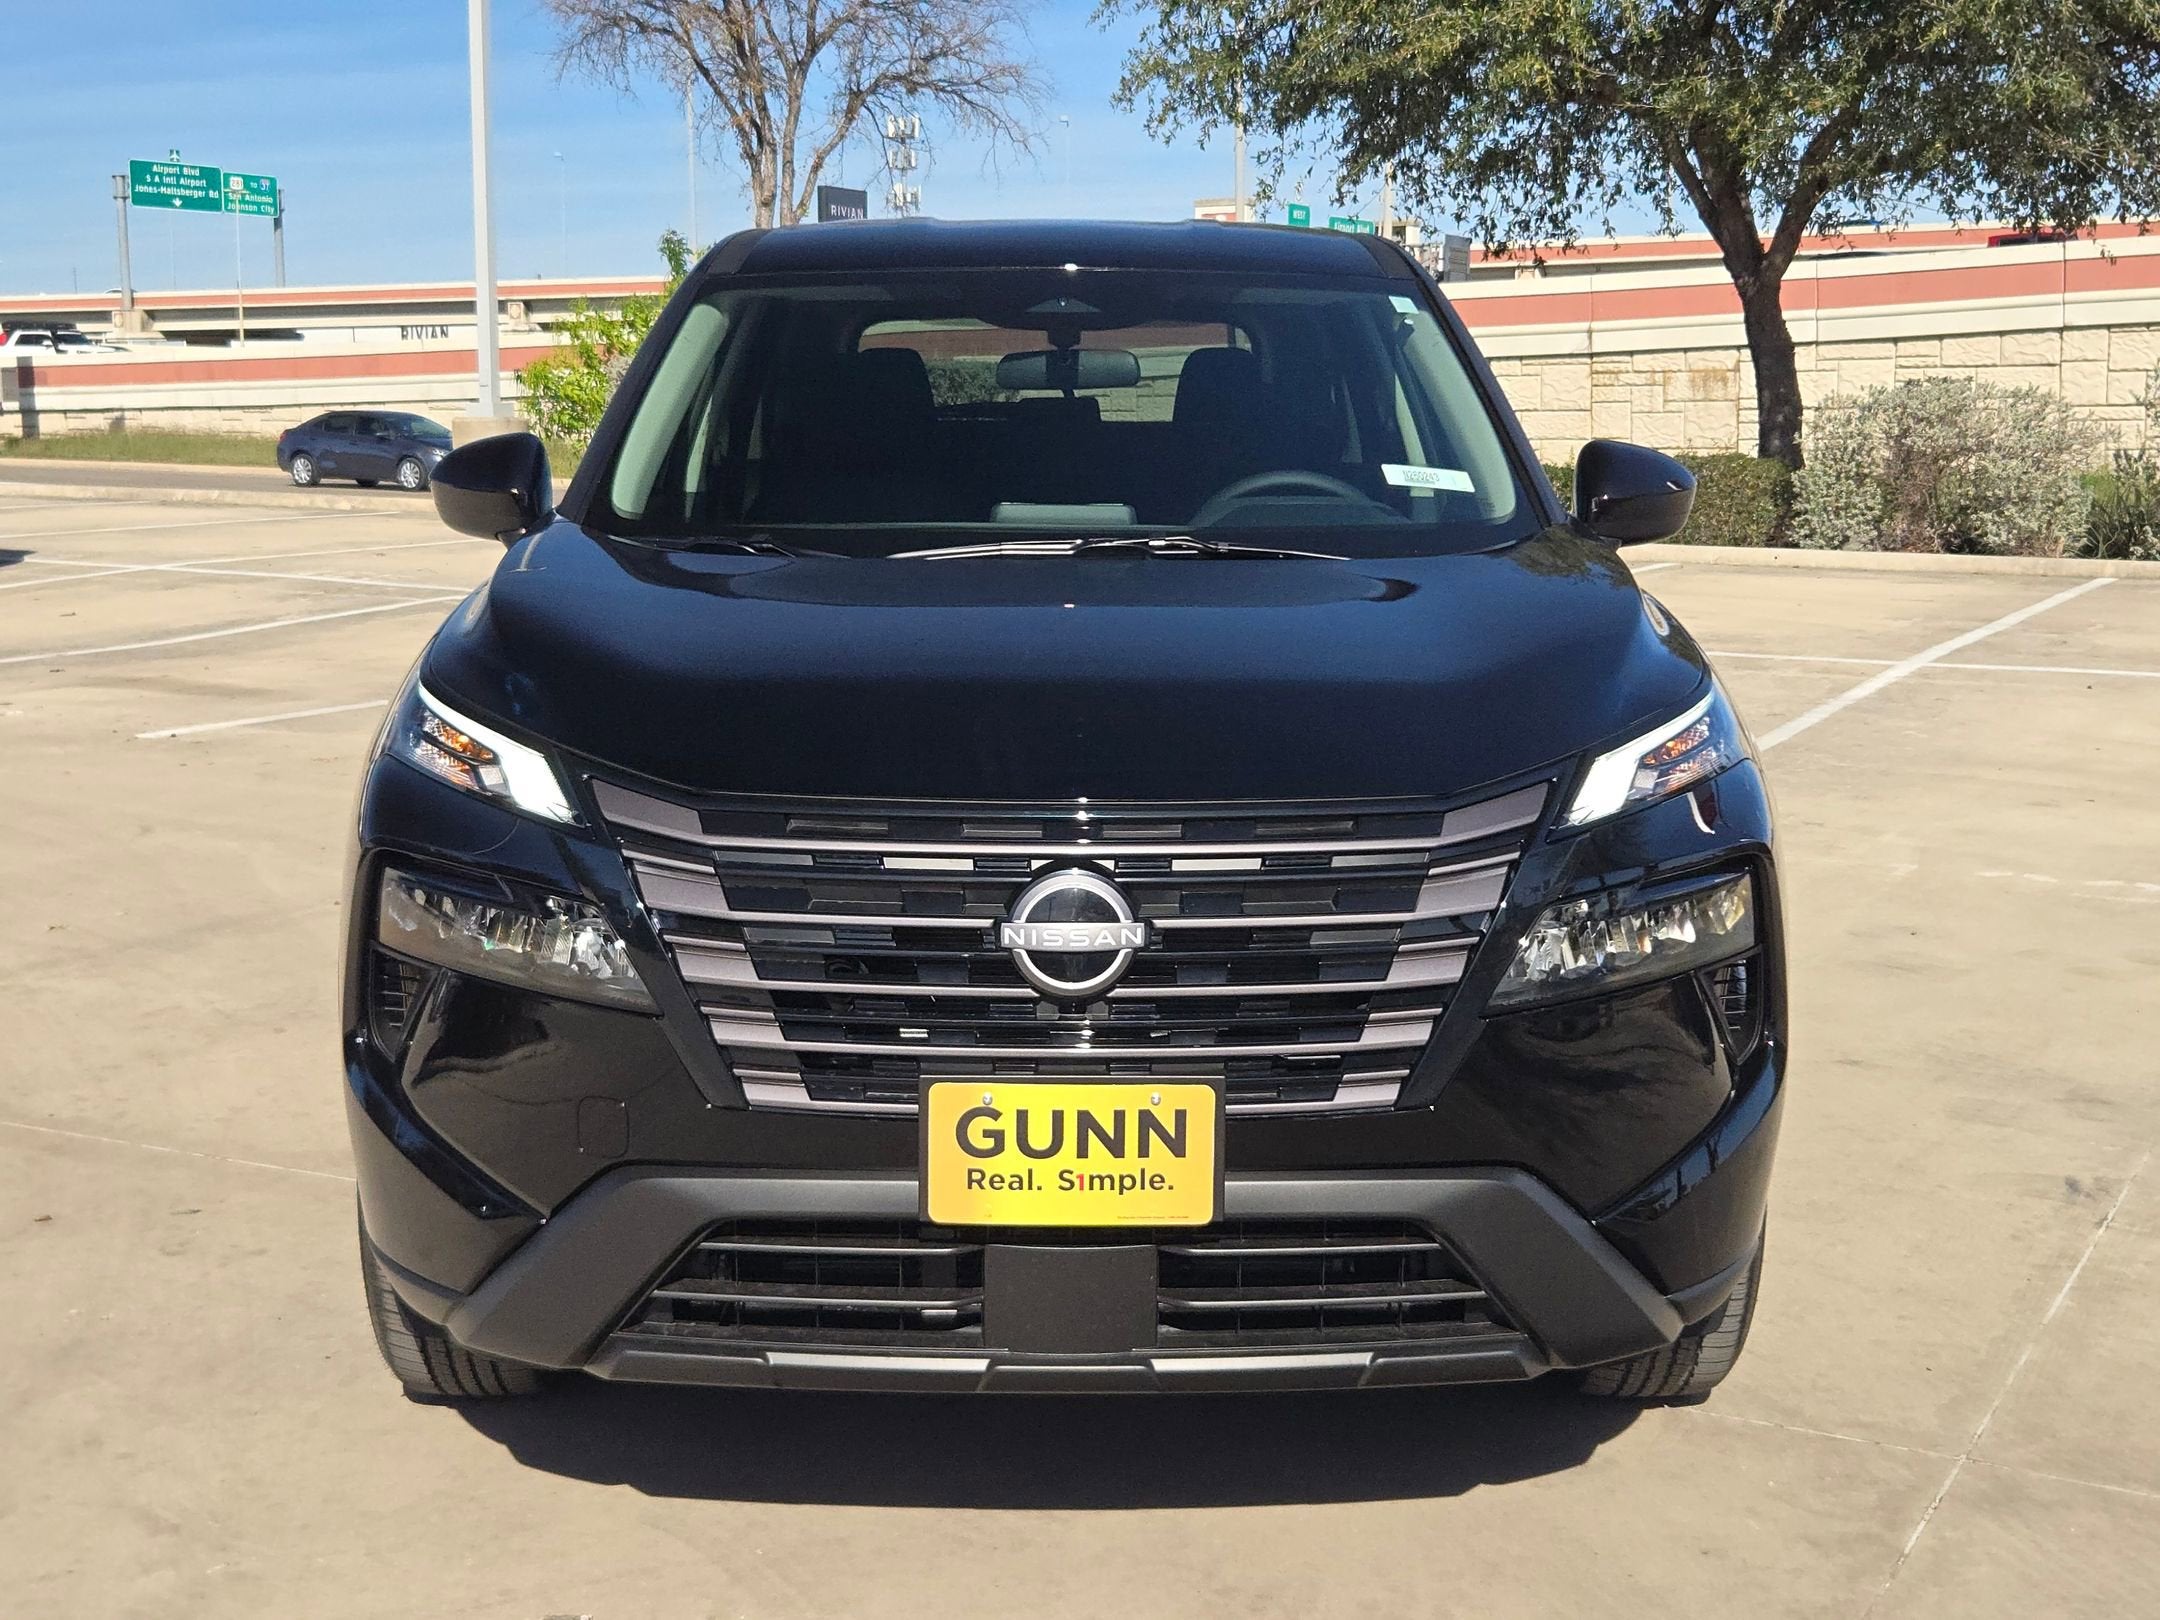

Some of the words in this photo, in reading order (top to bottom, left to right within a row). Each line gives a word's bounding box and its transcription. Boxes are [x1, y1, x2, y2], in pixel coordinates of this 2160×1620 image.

[152, 164, 180, 175] Airport
[183, 166, 200, 176] Blvd
[146, 175, 151, 183] S
[154, 175, 160, 183] A
[179, 177, 207, 188] Airport
[208, 190, 219, 199] Rd
[244, 193, 274, 204] Antonio
[260, 204, 275, 215] City
[831, 204, 864, 220] RIVIAN
[401, 325, 449, 341] RIVIAN
[1003, 927, 1142, 947] NISSAN
[955, 1106, 1188, 1160] GUNN
[966, 1167, 1043, 1191] Real.
[1057, 1167, 1175, 1196] S1mple.
